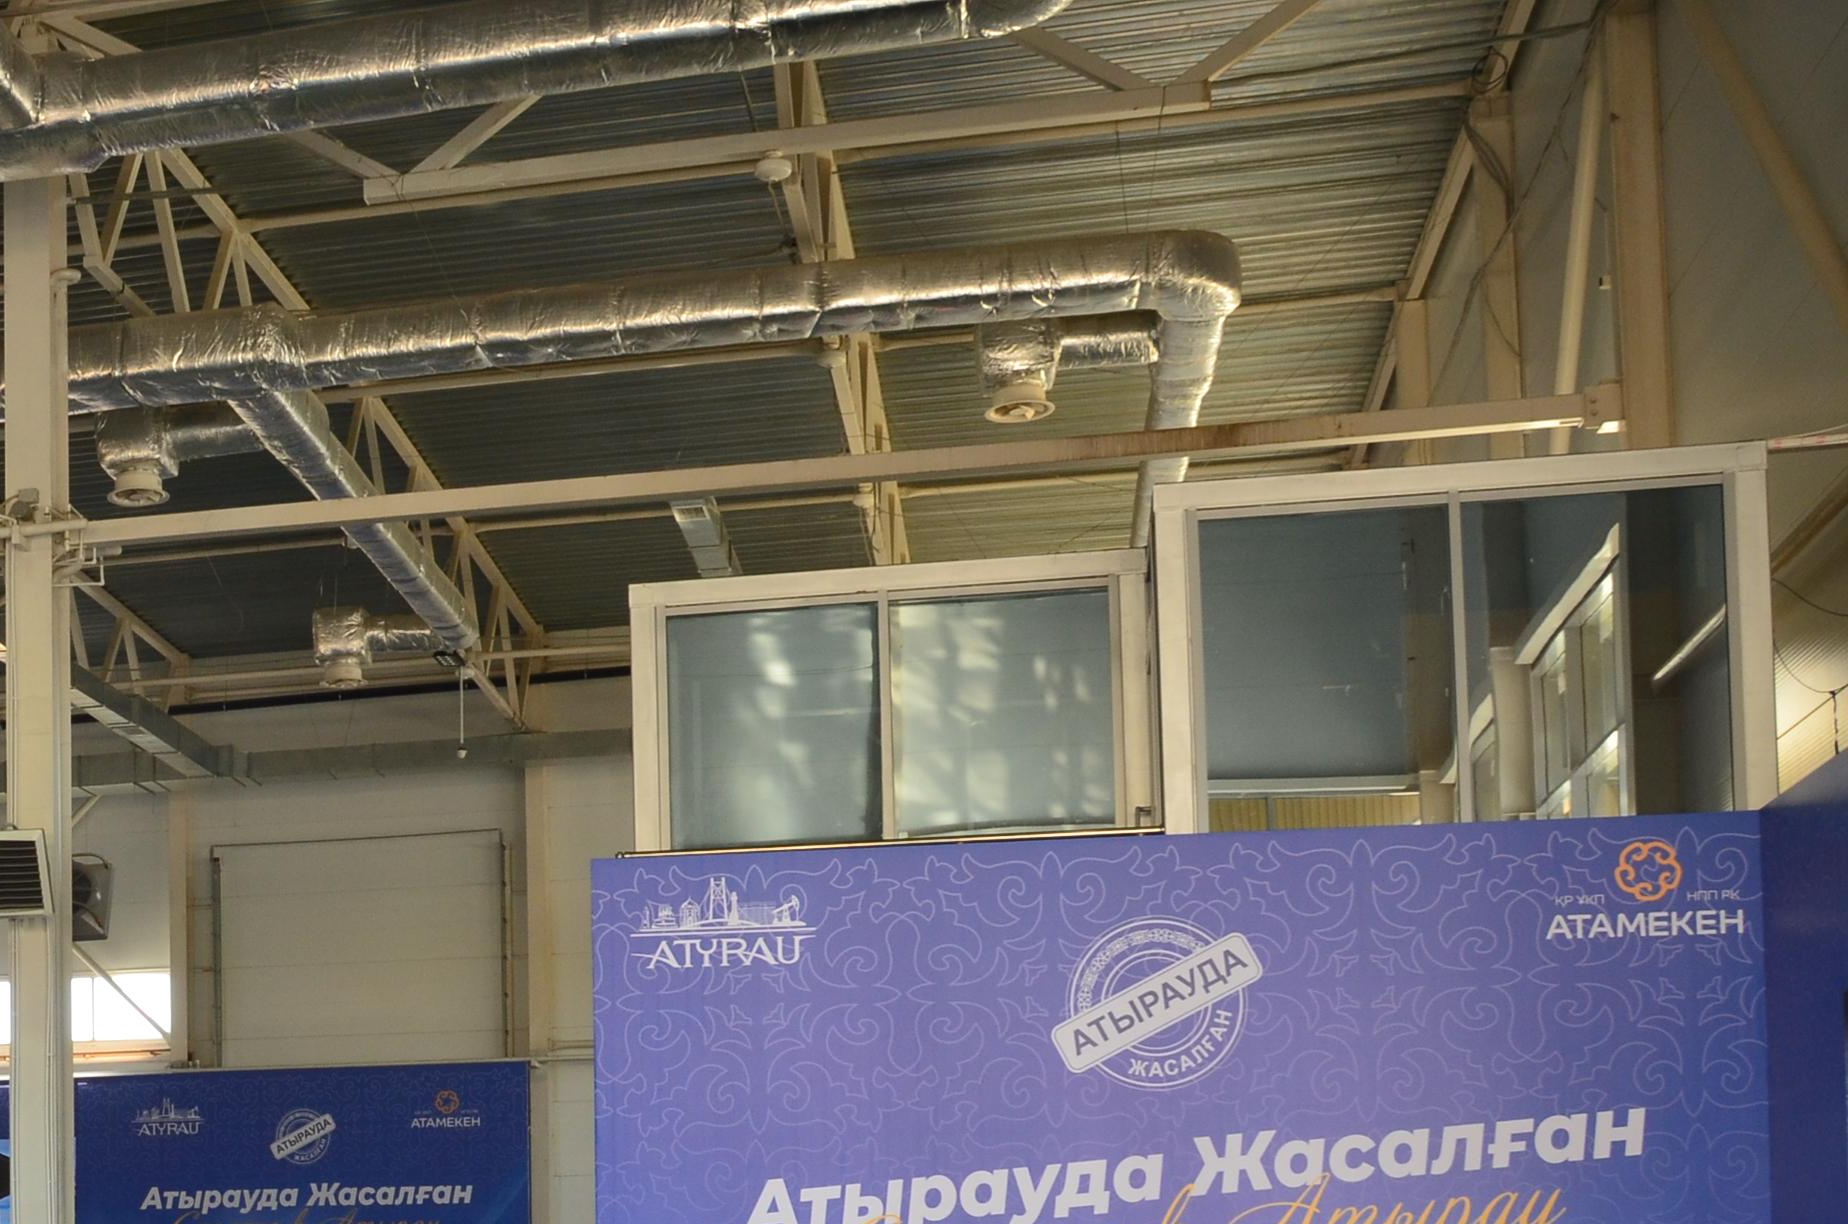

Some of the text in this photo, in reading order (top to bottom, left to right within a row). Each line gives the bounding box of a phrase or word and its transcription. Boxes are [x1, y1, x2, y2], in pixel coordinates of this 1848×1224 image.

[1686, 889, 1741, 901] НПП РК
[1546, 909, 1744, 940] АТАМЕКЕН
[631, 934, 817, 969] ATYRAU
[1072, 949, 1249, 1057] АТЫРАУДА
[1127, 1008, 1233, 1078] ЖАСАЛҒАН
[137, 1121, 201, 1137] ATYRAU
[275, 1117, 332, 1155] АТЫРАУДА
[411, 1116, 481, 1129] АТАМЕКЕН
[1189, 1107, 1646, 1197] Жасалған
[139, 1182, 474, 1215] Атырауда Жасалған
